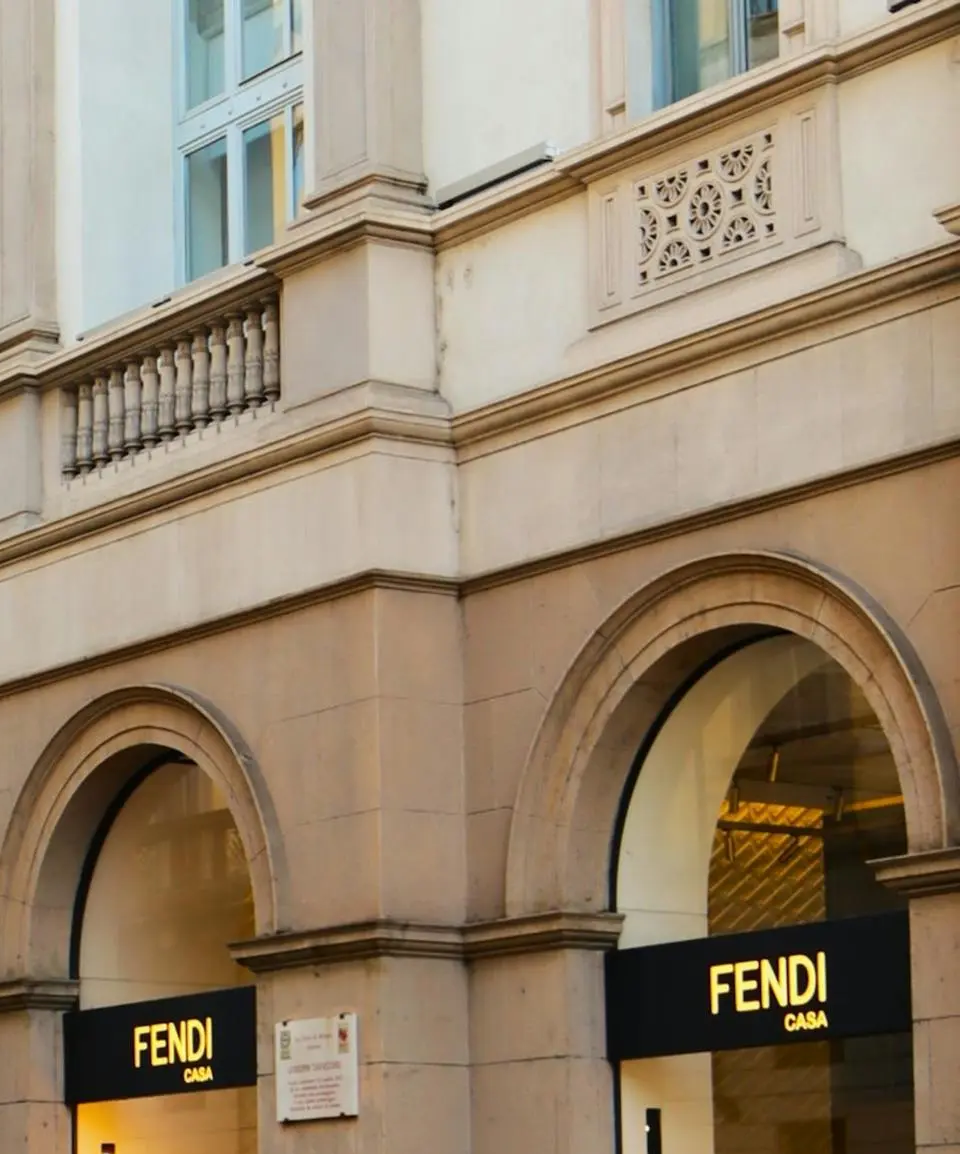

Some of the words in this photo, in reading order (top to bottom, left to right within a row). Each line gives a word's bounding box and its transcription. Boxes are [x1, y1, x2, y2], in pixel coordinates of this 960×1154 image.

[709, 951, 827, 1015] FENDI
[784, 1010, 828, 1032] CASA
[134, 1016, 213, 1068] FENDI
[183, 1066, 213, 1083] CASA
